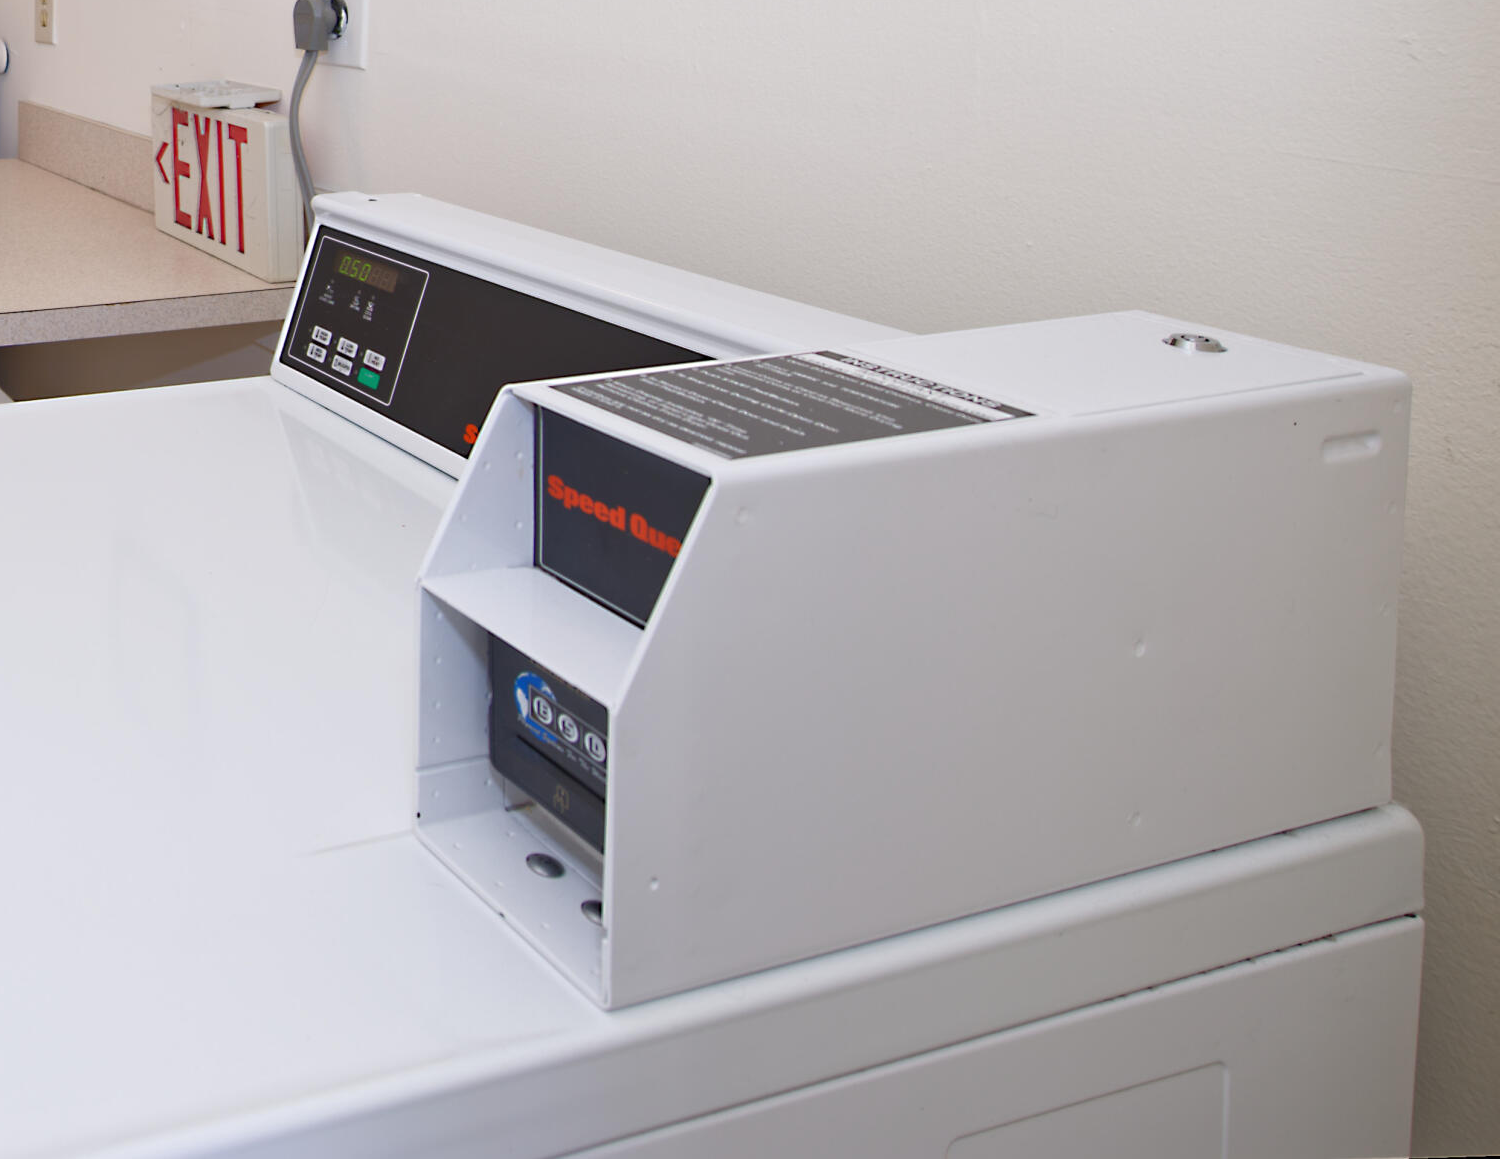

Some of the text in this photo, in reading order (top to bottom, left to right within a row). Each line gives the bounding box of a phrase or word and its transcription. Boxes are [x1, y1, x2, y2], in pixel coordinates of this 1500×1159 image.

[172, 107, 248, 254] EXIT
[840, 357, 1002, 409] INSTRUCTIONS
[548, 474, 682, 558] Speed Que
